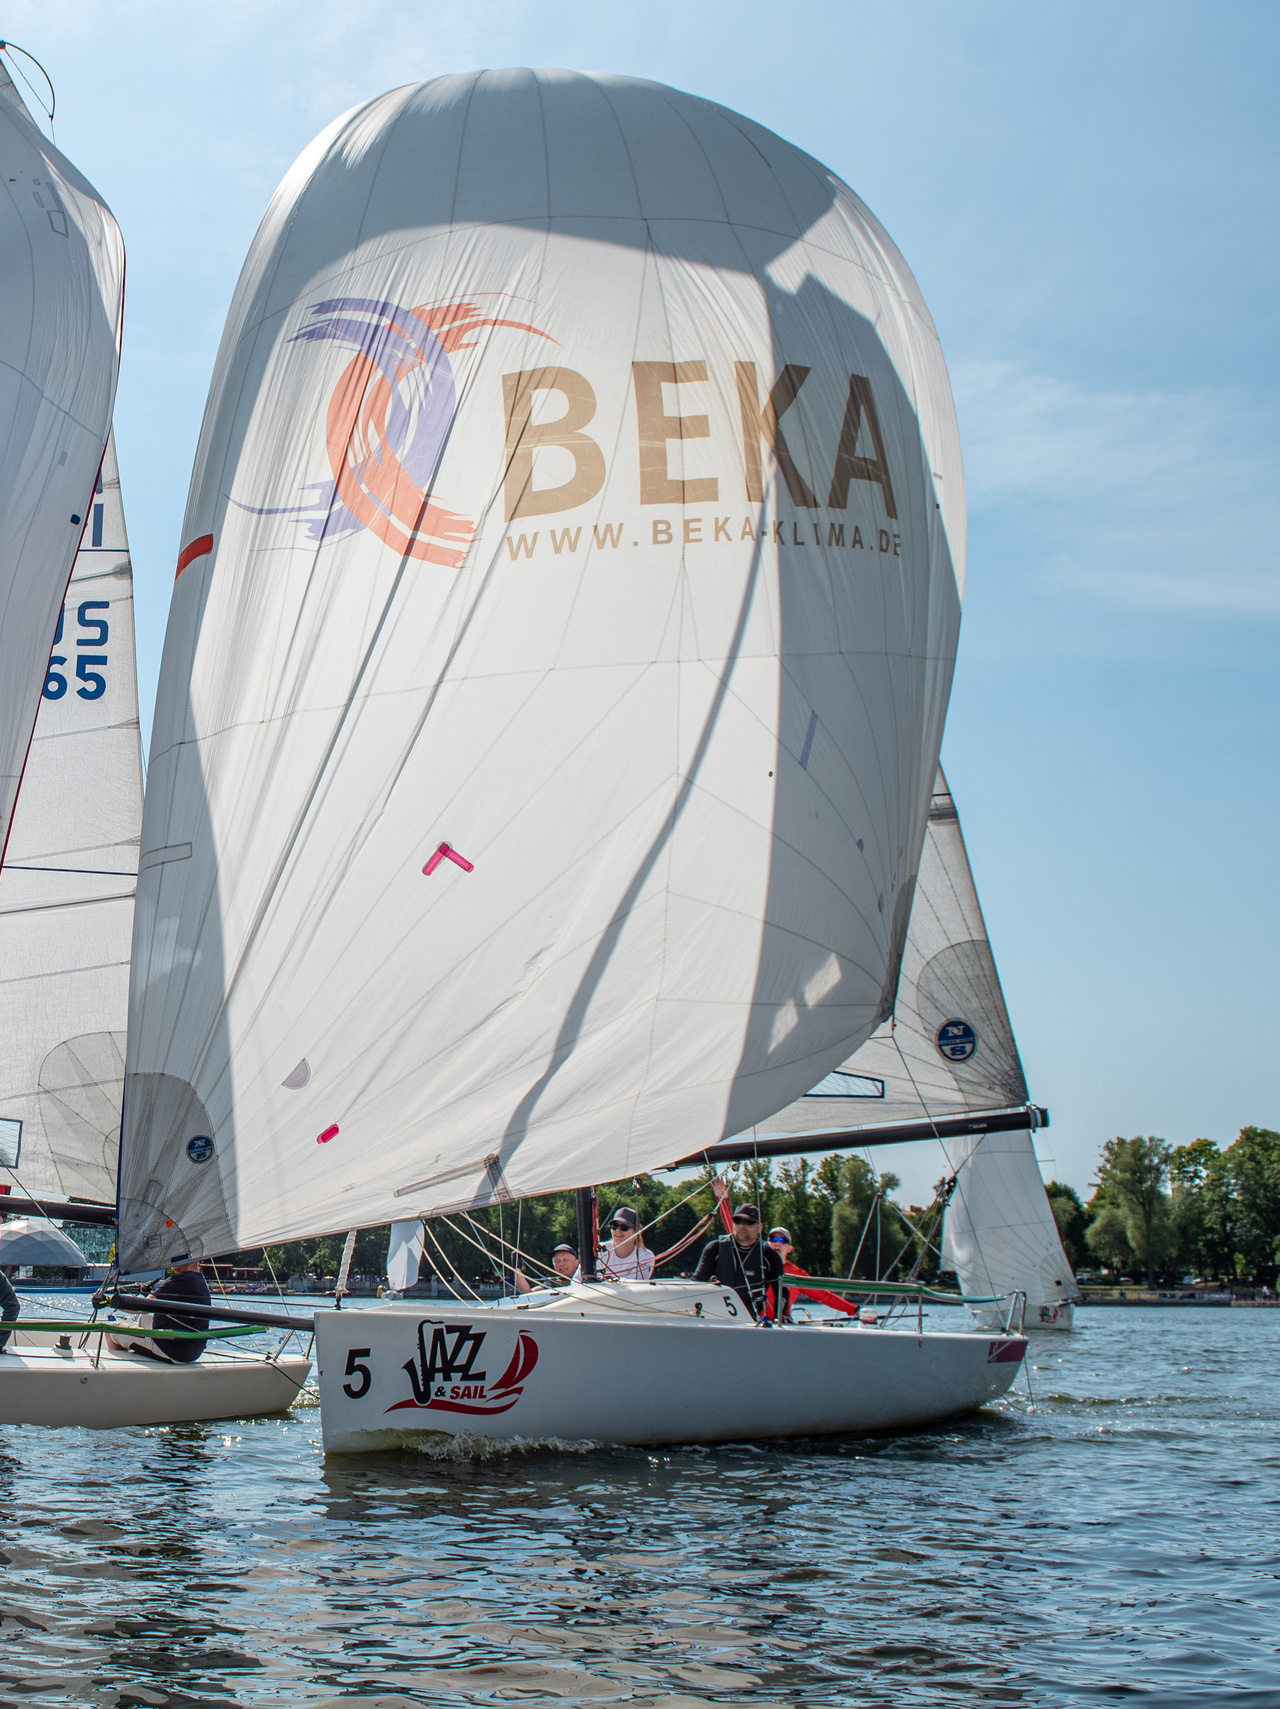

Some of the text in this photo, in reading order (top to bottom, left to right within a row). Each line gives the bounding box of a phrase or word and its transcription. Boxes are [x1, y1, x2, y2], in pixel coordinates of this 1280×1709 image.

[501, 359, 899, 523] BEKA
[506, 516, 902, 562] WWW.BEKA-KLIMA.DE
[41, 654, 108, 700] 65
[723, 1296, 738, 1317] 5
[342, 1347, 371, 1399] 5
[401, 1319, 487, 1405] JAZZ
[434, 1385, 487, 1400] & SAIL
